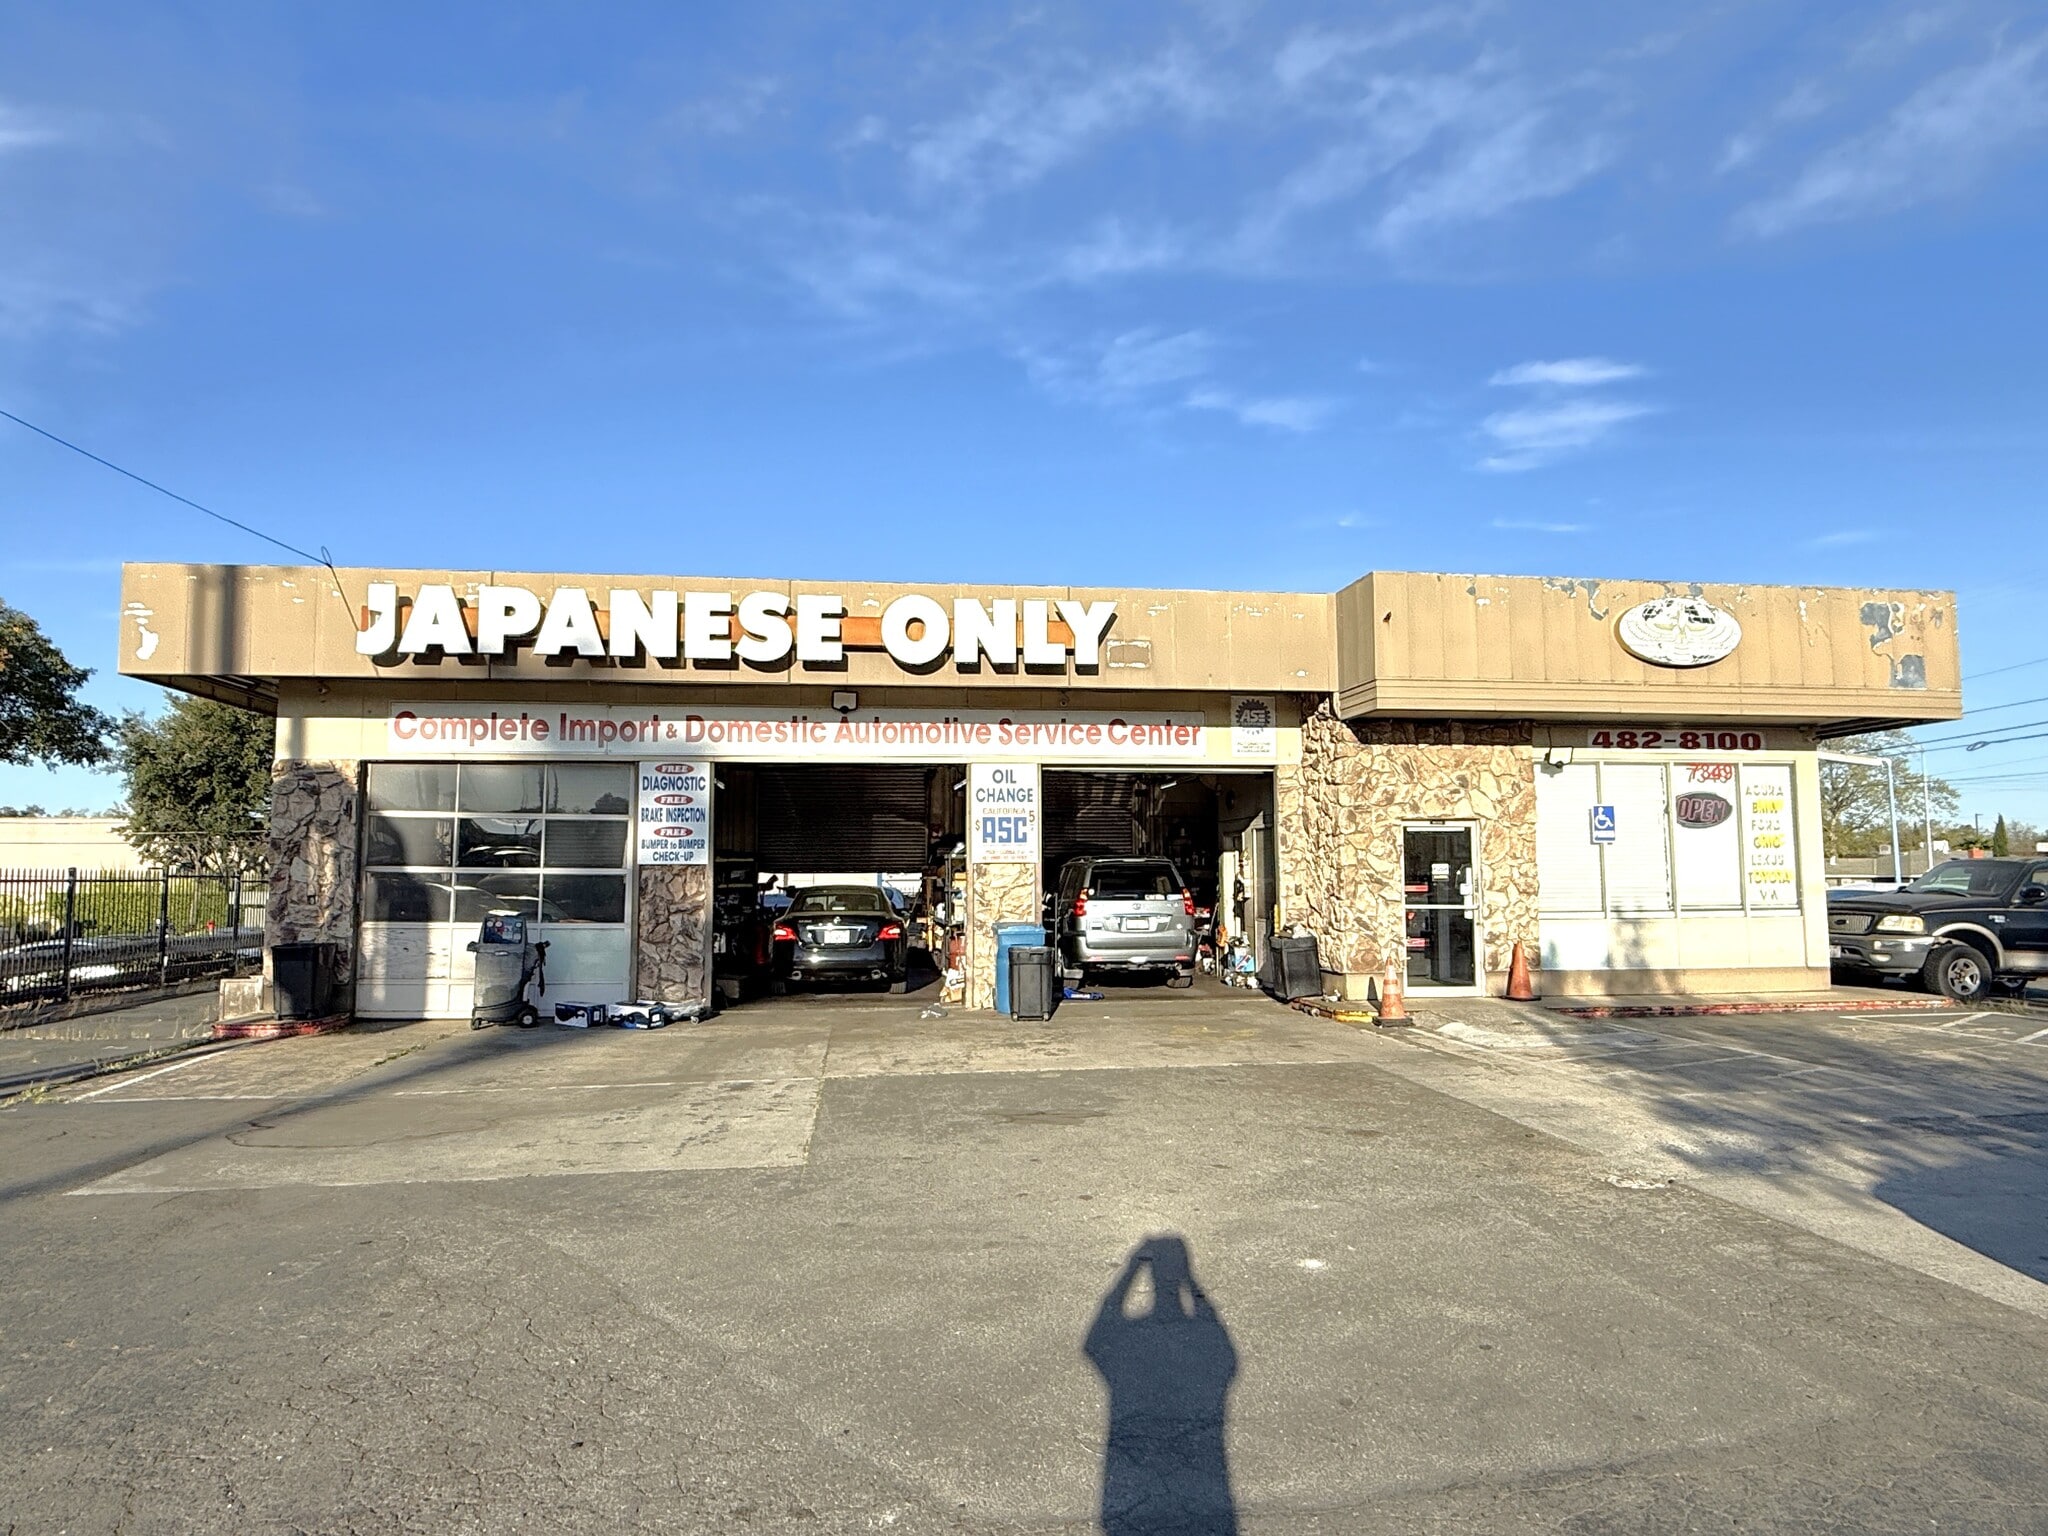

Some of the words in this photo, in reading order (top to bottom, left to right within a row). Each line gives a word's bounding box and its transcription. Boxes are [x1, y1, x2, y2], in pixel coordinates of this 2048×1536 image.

[355, 583, 843, 664] JAPANESE
[881, 594, 1118, 666] ONLY
[1240, 709, 1266, 722] ASE
[393, 711, 550, 747] Complete
[559, 713, 661, 748] Import
[666, 723, 678, 740] &
[685, 715, 827, 744] Domestic
[834, 716, 992, 745] Automotive
[998, 718, 1102, 746] Service
[1107, 718, 1201, 747] Center
[1591, 731, 1762, 751] 482-8100
[661, 765, 689, 773] FREE
[992, 769, 1017, 784] OIL
[642, 775, 706, 791] DIAGNOSTIC
[659, 796, 687, 804] FREE
[975, 787, 1034, 803] CHANGE
[641, 807, 663, 823] BRAKE
[666, 807, 706, 823] INSPECTION
[1678, 797, 1726, 822] OPEN
[659, 828, 687, 836] FREE
[982, 817, 1027, 843] ASC
[641, 839, 669, 850] BUMPER
[670, 841, 678, 850] to
[678, 839, 706, 850] BUMPER
[652, 851, 694, 862] CHECK-UP
